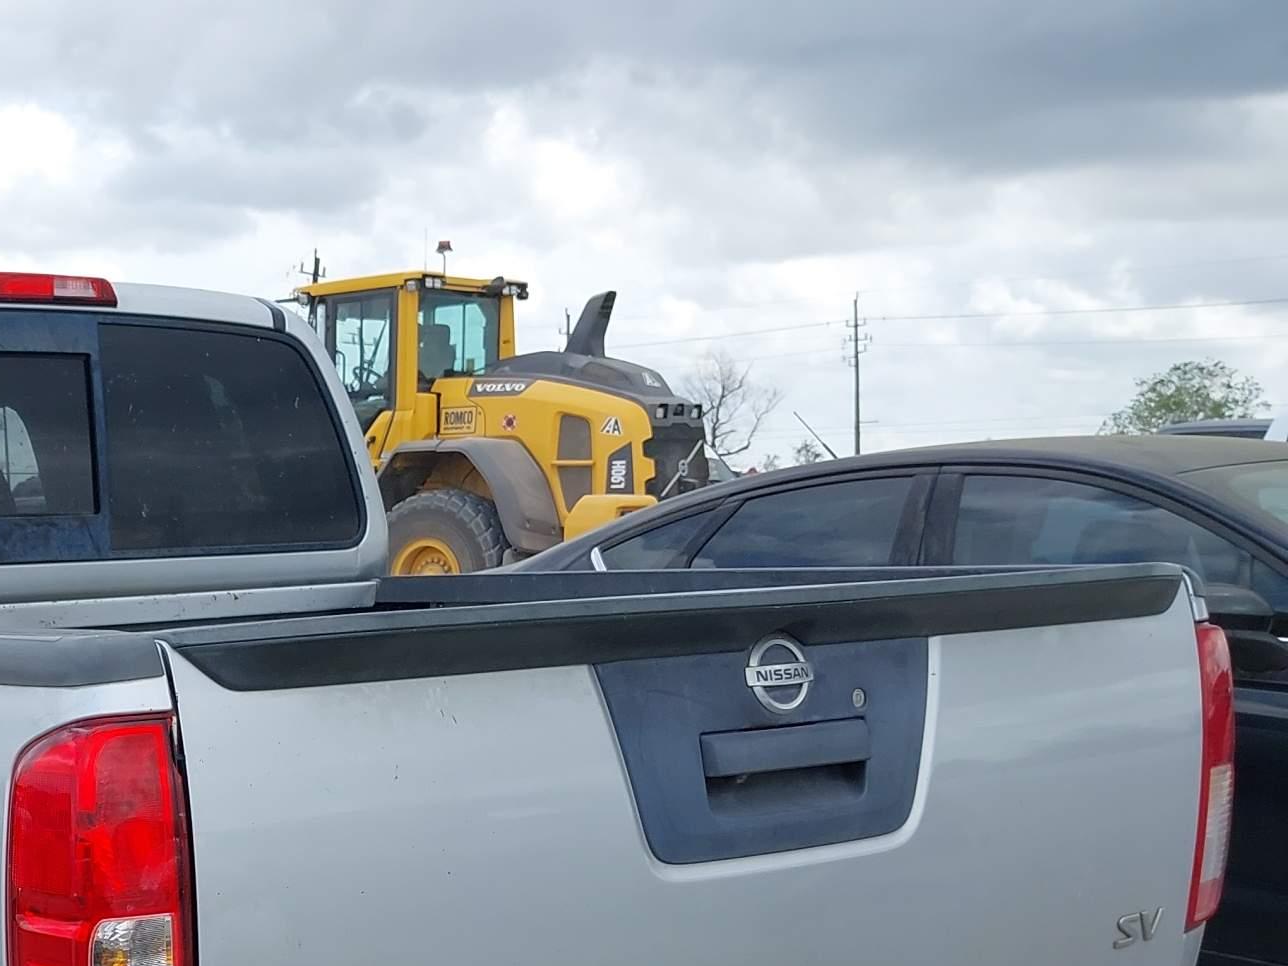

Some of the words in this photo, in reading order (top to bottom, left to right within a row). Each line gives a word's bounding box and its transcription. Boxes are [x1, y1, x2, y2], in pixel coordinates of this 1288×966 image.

[475, 383, 526, 393] VOLVO
[444, 410, 473, 425] ROMCO
[610, 460, 626, 489] L90H
[755, 667, 809, 683] NISSAN
[1112, 905, 1165, 950] SV
